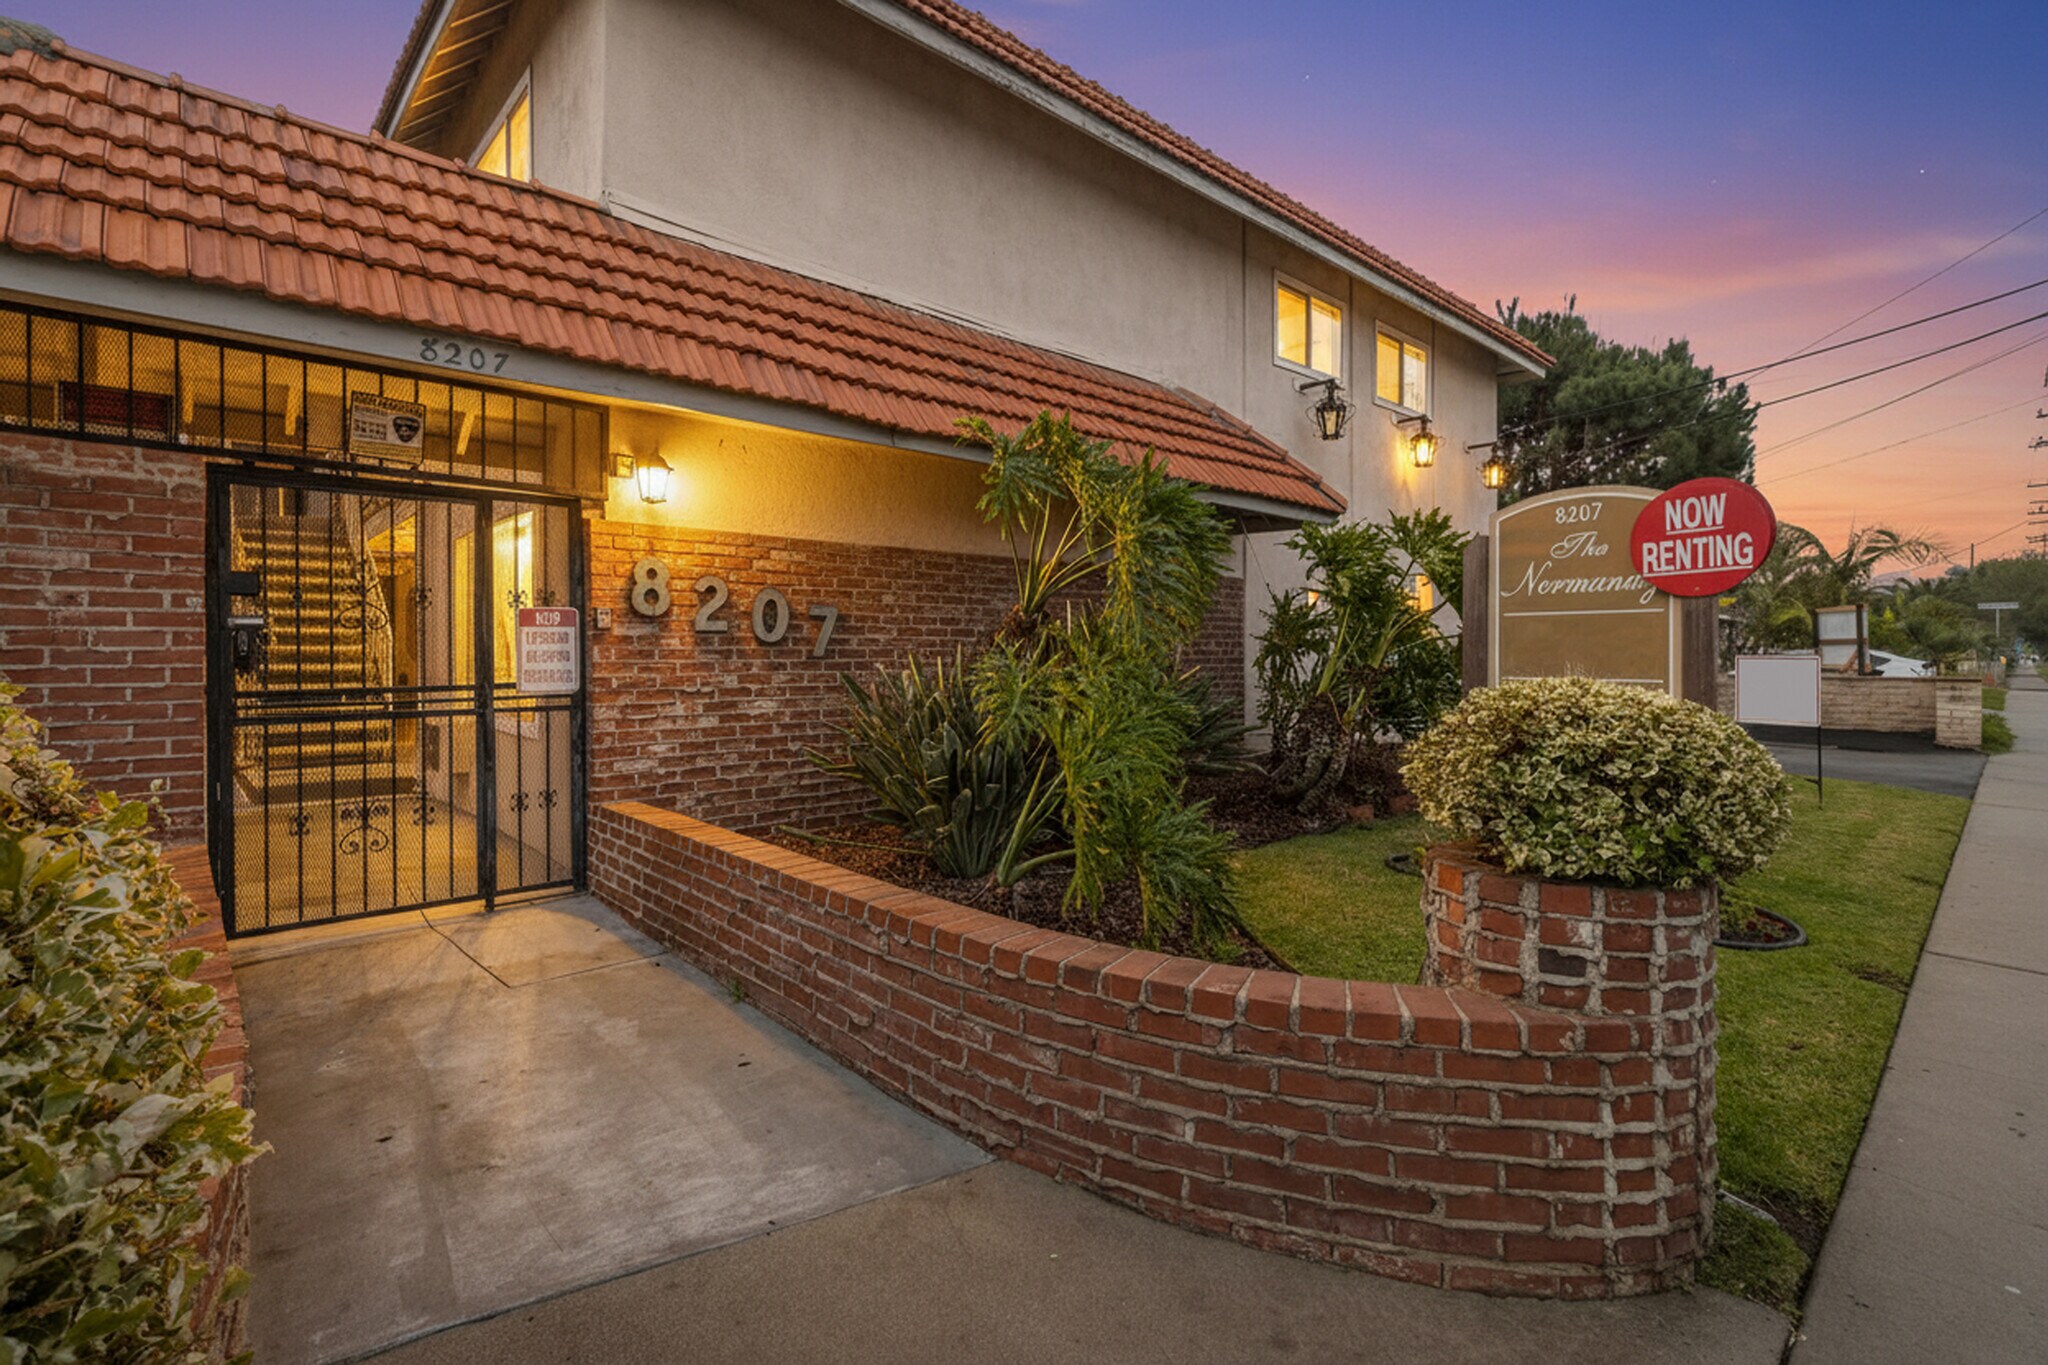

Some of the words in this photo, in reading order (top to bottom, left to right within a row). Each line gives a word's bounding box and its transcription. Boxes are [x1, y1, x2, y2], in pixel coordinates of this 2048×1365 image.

[420, 338, 509, 373] 8207
[1555, 502, 1602, 524] 8207
[1665, 493, 1726, 531] NOW
[1550, 531, 1609, 559] The
[1642, 532, 1753, 573] RENTING
[631, 556, 839, 657] 8207
